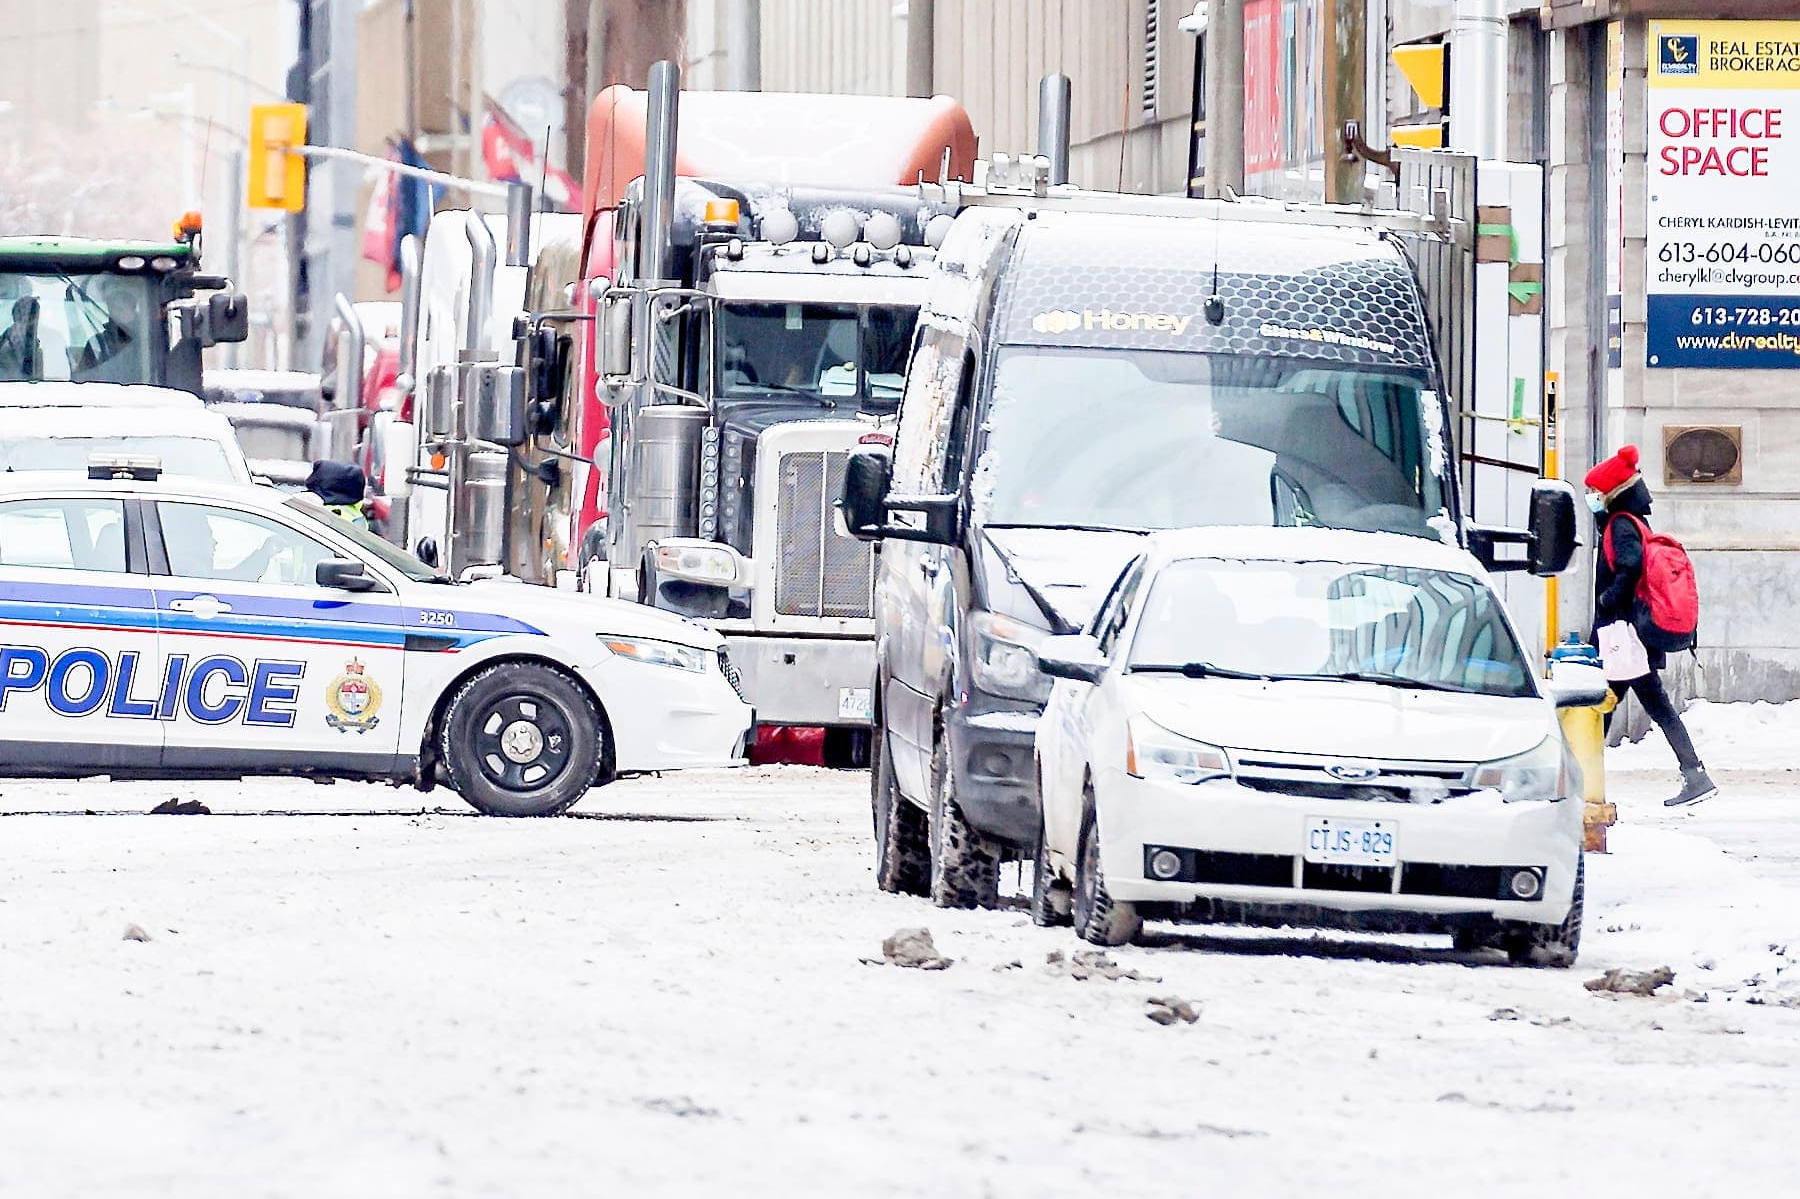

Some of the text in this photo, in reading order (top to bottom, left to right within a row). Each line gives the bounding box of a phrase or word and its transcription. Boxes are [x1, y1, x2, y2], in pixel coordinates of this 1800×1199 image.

[1710, 41, 1749, 55] REAL
[1659, 107, 1782, 139] OFFICE
[1660, 145, 1769, 177] SPACE
[1658, 216, 1800, 229] CHERYL KARDISH-LEVIT
[1658, 242, 1800, 264] 613-604-060
[1083, 307, 1191, 336] Honey
[1691, 307, 1800, 326] 613-728-20
[419, 610, 455, 627] 3250
